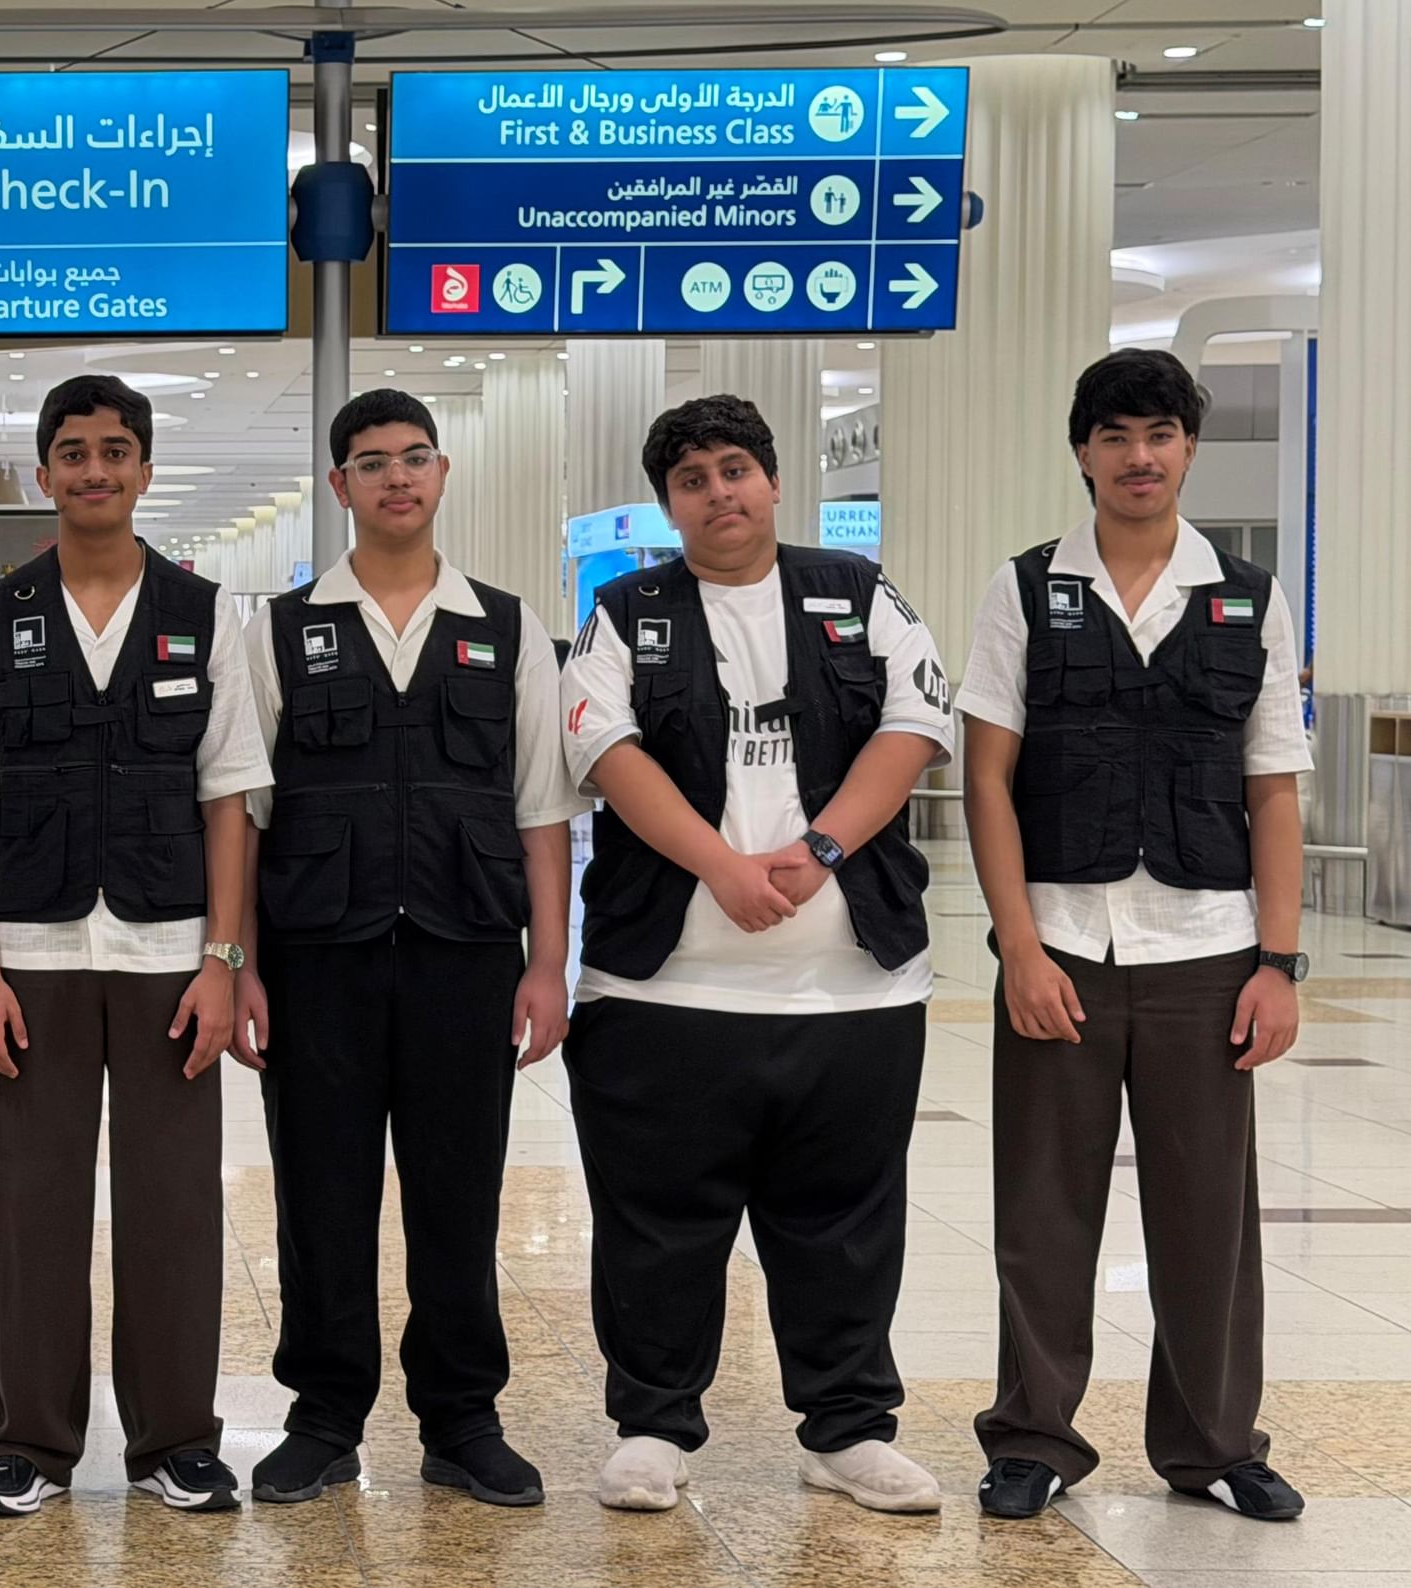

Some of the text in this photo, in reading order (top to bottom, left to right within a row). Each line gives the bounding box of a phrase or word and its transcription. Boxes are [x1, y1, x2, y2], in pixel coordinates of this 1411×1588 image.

[479, 83, 795, 113] الدرجة الأولى ورجال الأعمال
[87, 113, 213, 157] إجراءات
[501, 118, 794, 145] First & Business Class
[608, 177, 701, 200] المرافقين
[706, 179, 734, 200] غير
[519, 205, 796, 232] Unaccompanied Minors
[63, 266, 120, 291] جميع
[690, 281, 724, 294] ATM
[89, 294, 167, 319] Gates
[825, 510, 878, 522] URREN
[824, 526, 879, 537] XCHAN
[743, 738, 791, 766] BETT
